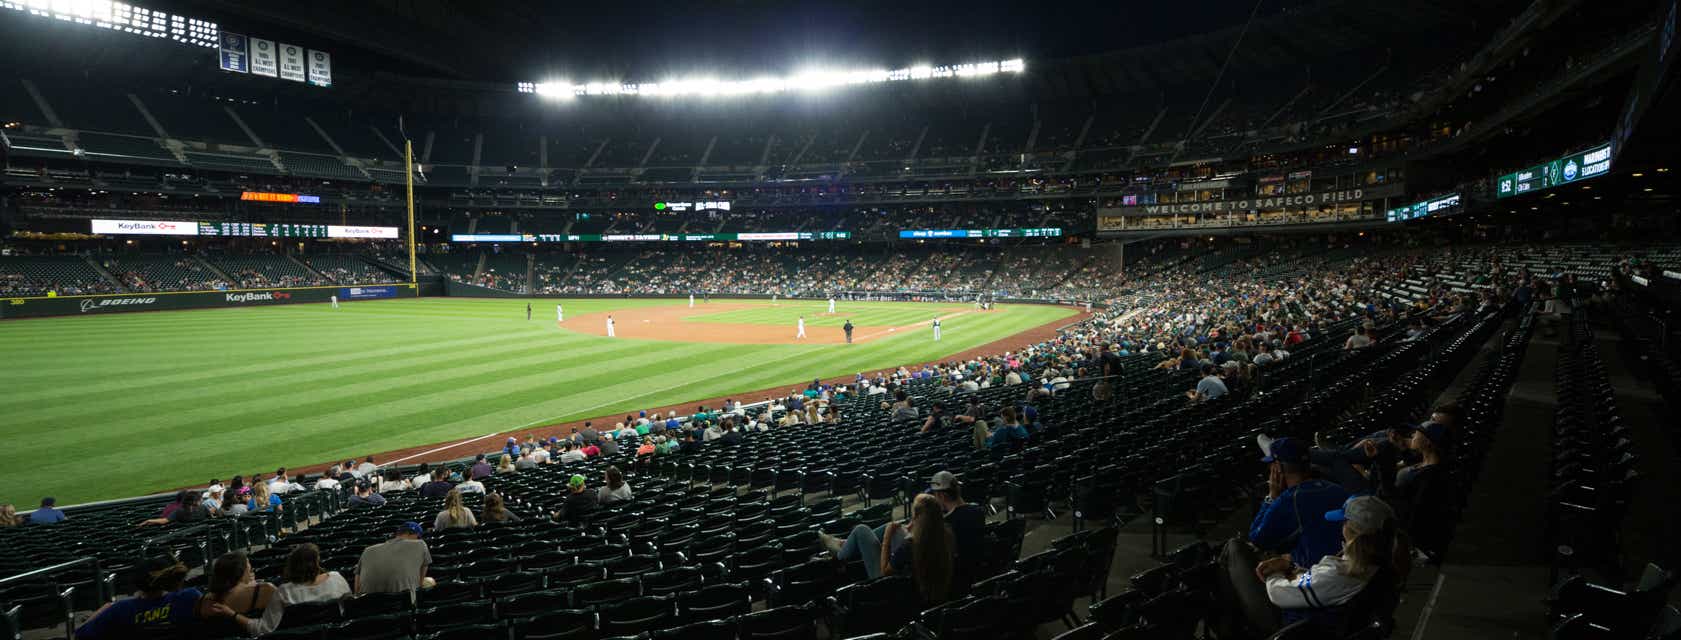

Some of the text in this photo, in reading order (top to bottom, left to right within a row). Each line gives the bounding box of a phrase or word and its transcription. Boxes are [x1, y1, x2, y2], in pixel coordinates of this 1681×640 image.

[1147, 189, 1363, 215] WELCOME TO SAFECO FIELD
[119, 222, 155, 230] KeyBank
[100, 297, 156, 307] BOEING
[226, 292, 273, 303] KeyBank
